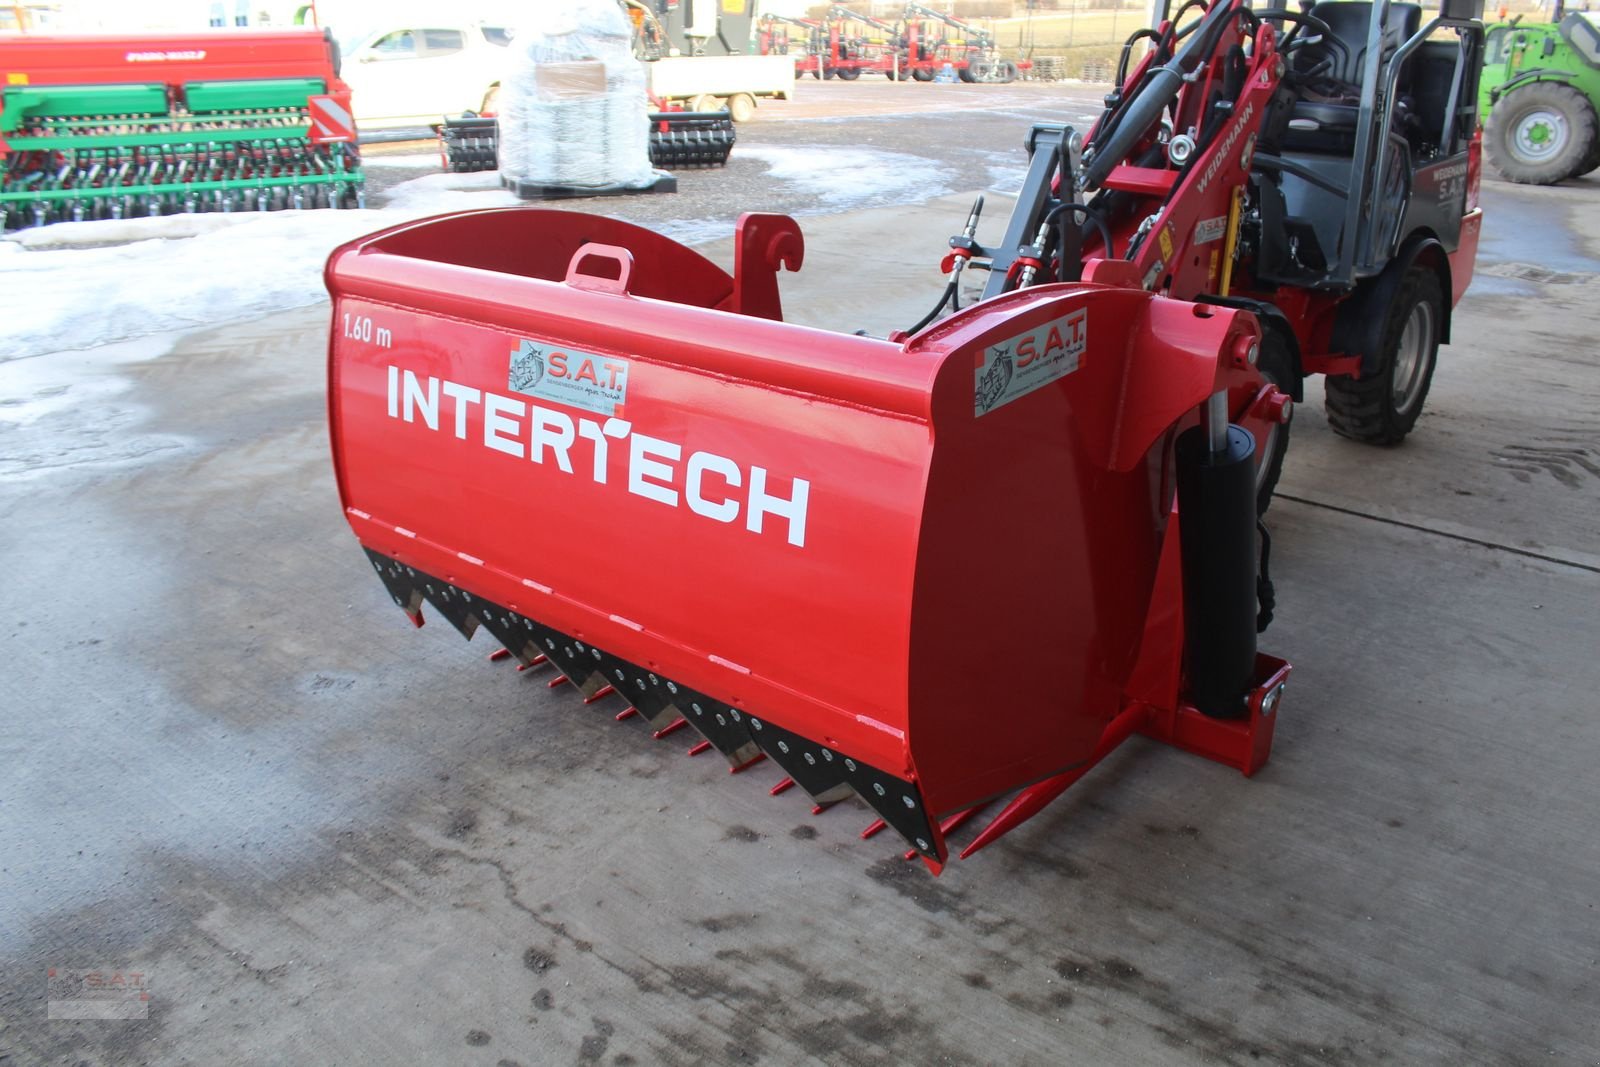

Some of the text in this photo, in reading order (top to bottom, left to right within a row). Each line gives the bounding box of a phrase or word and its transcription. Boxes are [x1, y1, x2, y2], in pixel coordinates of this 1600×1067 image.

[1197, 101, 1254, 194] WEIDEMANN
[344, 312, 392, 349] 1.60 m
[1016, 314, 1085, 368] S.A.T.
[547, 351, 625, 393] S.A.T.
[387, 365, 811, 548] INTERTECH
